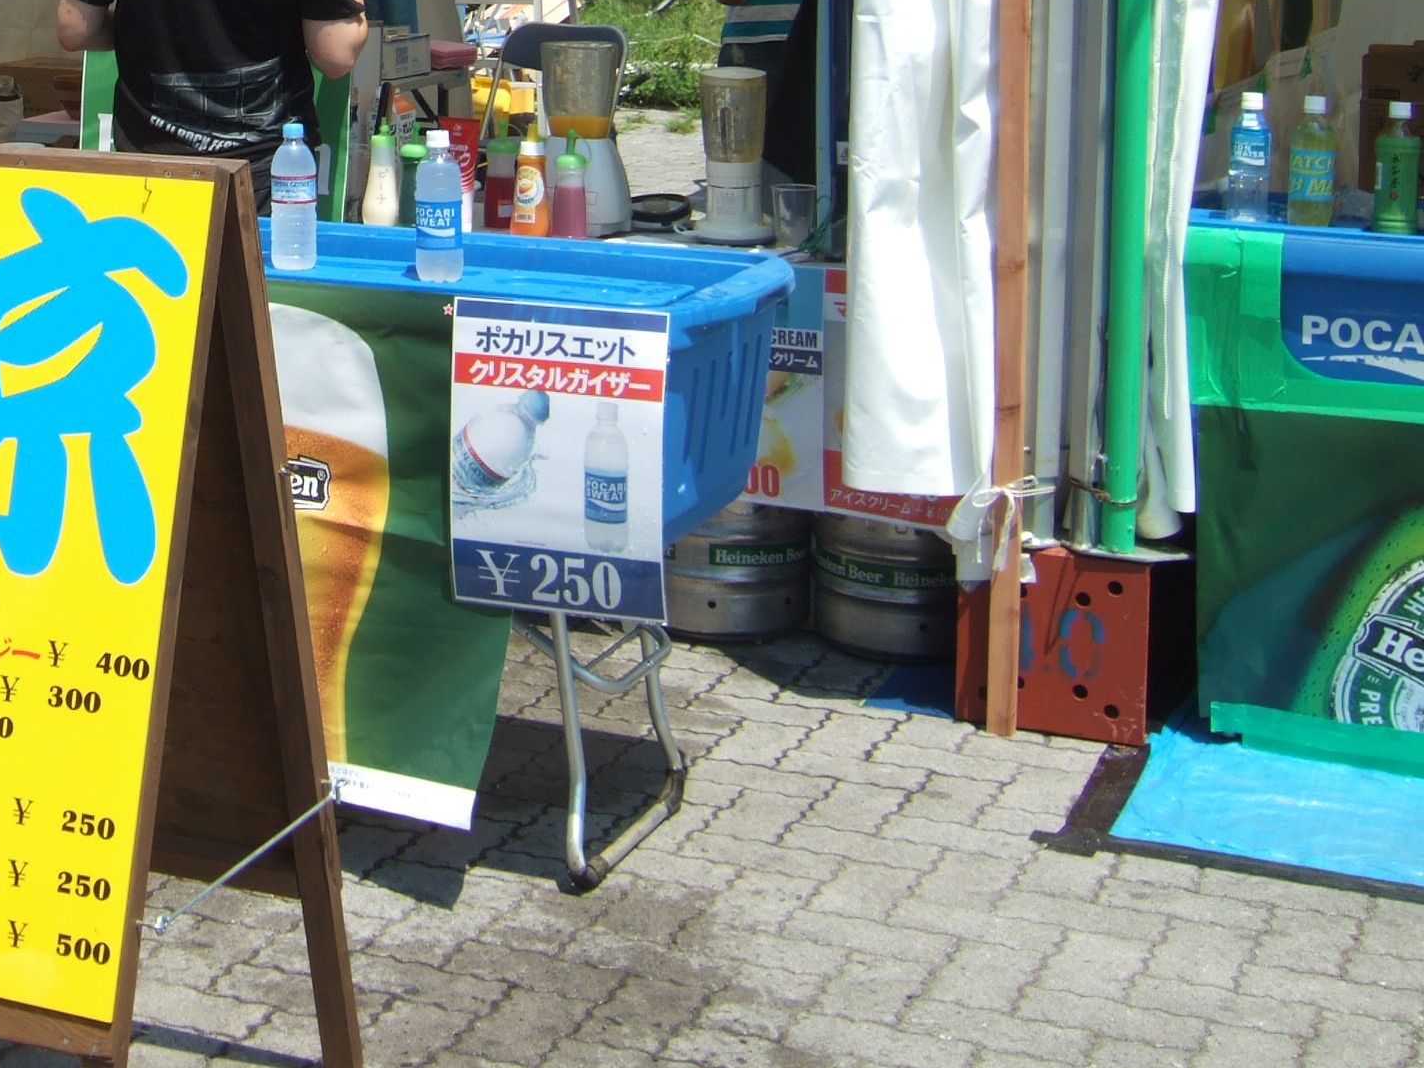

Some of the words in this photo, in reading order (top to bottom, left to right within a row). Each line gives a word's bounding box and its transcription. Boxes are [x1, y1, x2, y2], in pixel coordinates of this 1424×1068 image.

[475, 325, 637, 365] ポカリスエット
[770, 351, 818, 369] クリーム
[468, 359, 652, 398] クリスタルガイザー
[714, 548, 783, 565] Heineken
[848, 564, 884, 584] Beer
[96, 651, 151, 681] 400
[48, 685, 102, 714] 300
[61, 810, 116, 841] 250
[57, 870, 112, 901] 250
[56, 933, 111, 966] 500
